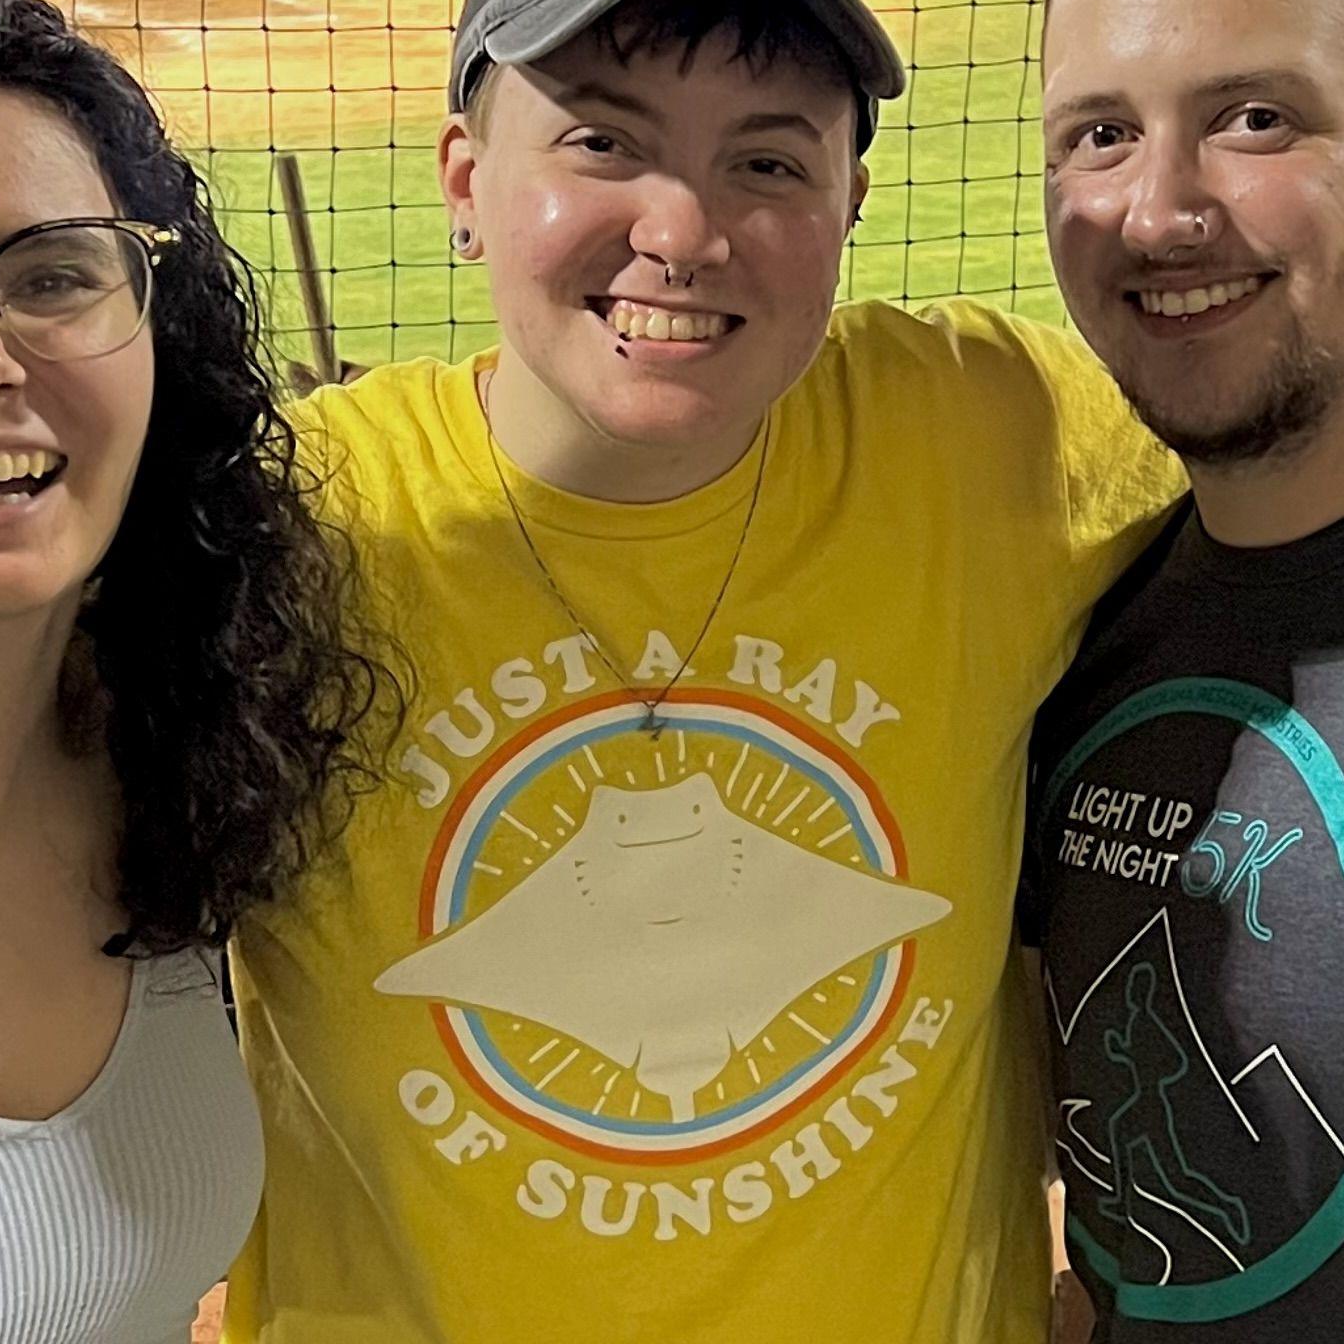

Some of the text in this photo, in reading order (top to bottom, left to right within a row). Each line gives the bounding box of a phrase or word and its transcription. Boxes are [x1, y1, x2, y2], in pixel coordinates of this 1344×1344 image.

[401, 629, 901, 808] JUST A RAY
[1058, 829, 1179, 888] THE NIGHT
[1068, 781, 1194, 841] LIGHT UP
[1180, 808, 1304, 942] 5K
[398, 996, 953, 1240] OF SUNSHINE
